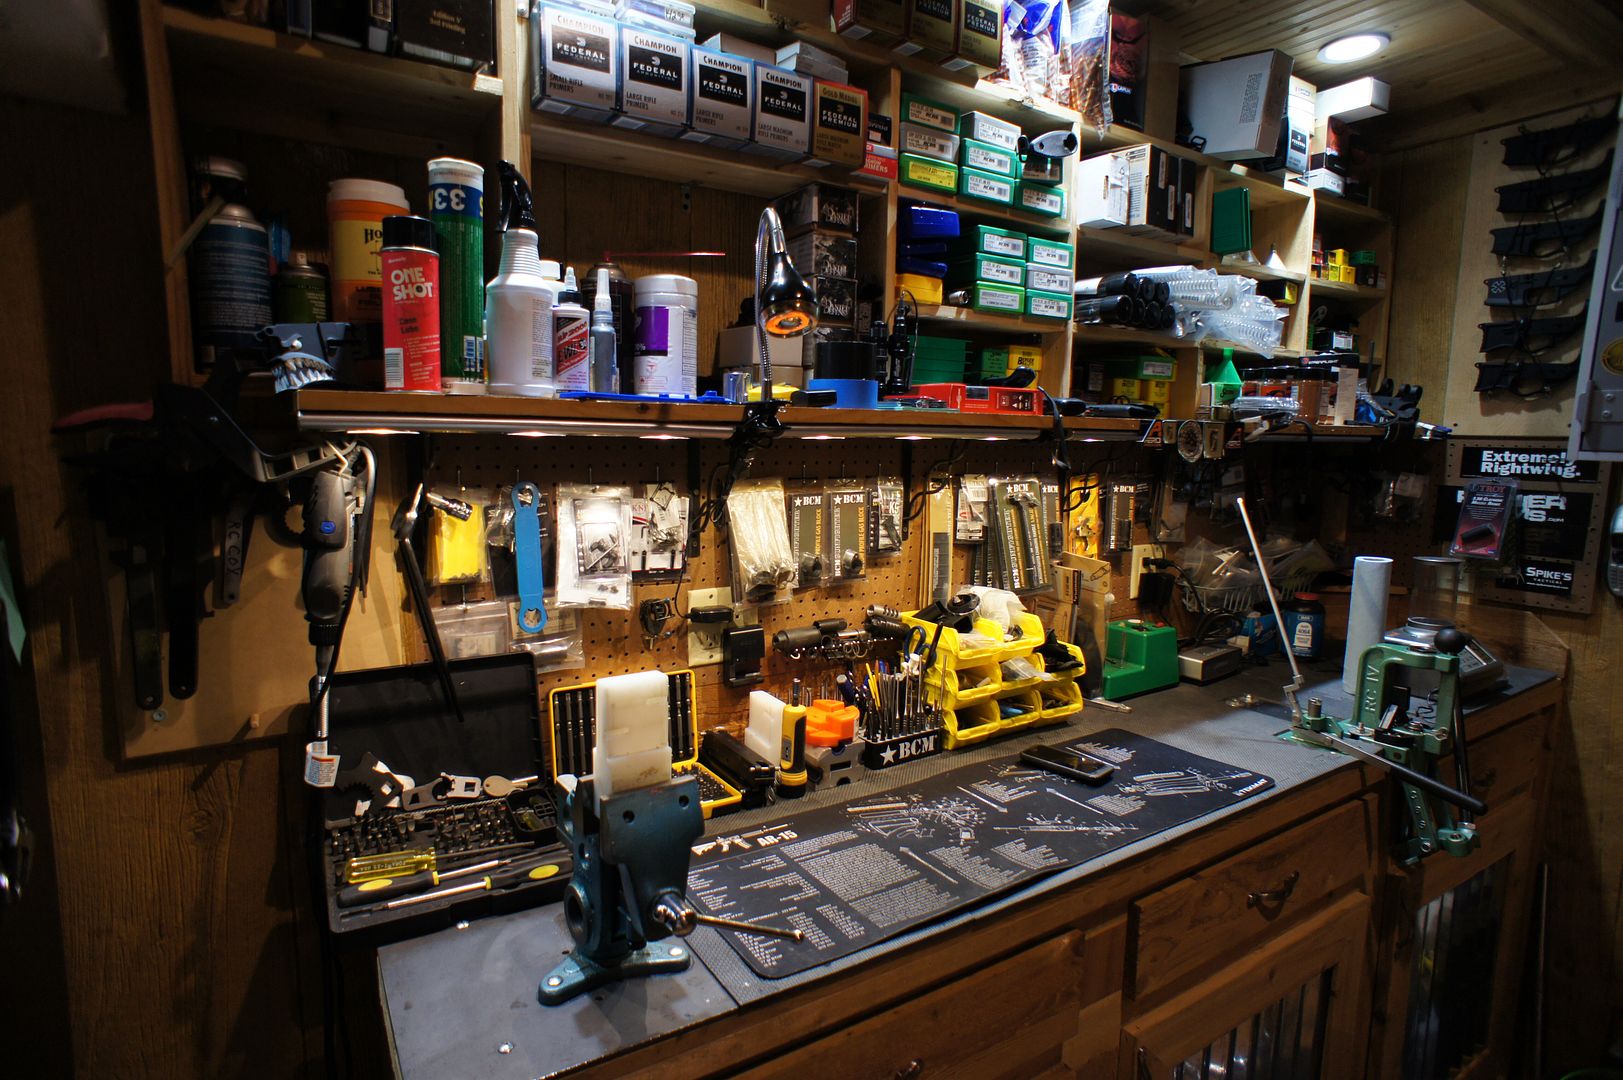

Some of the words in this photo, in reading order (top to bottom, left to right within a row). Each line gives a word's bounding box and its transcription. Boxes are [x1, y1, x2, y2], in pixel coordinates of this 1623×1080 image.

[557, 15, 604, 34] CHAMPION
[967, 14, 996, 28] FEDERAL
[967, 19, 996, 33] PREMIUM
[556, 43, 605, 60] FEDERAL
[635, 35, 677, 54] CHAMPION
[633, 62, 678, 79] FEDERAL
[703, 55, 742, 72] CHAMPION
[549, 81, 574, 93] PRIMERS
[569, 78, 583, 87] RIFLE
[766, 72, 802, 89] CHAMPION
[703, 80, 744, 96] FEDERAL
[626, 92, 641, 102] LARGE
[643, 95, 657, 104] RIFLE
[626, 99, 649, 111] PRIMERS
[764, 96, 803, 112] FEDERAL
[822, 109, 857, 123] FEDERAL
[822, 116, 858, 129] PREMIUM
[864, 163, 889, 173] RIMERS
[391, 267, 425, 285] ONE
[393, 283, 433, 301] SHOT
[1013, 483, 1029, 492] BCM
[1047, 485, 1059, 493] BCM
[1120, 485, 1134, 493] BCM
[1479, 485, 1506, 493] TROY
[803, 496, 822, 505] BCM
[844, 494, 864, 504] BCM
[1525, 567, 1572, 581] SPIKE'S
[1366, 664, 1380, 683] IV
[1365, 689, 1377, 712] RC
[899, 735, 935, 759] BCM
[757, 830, 798, 847] AR-15
